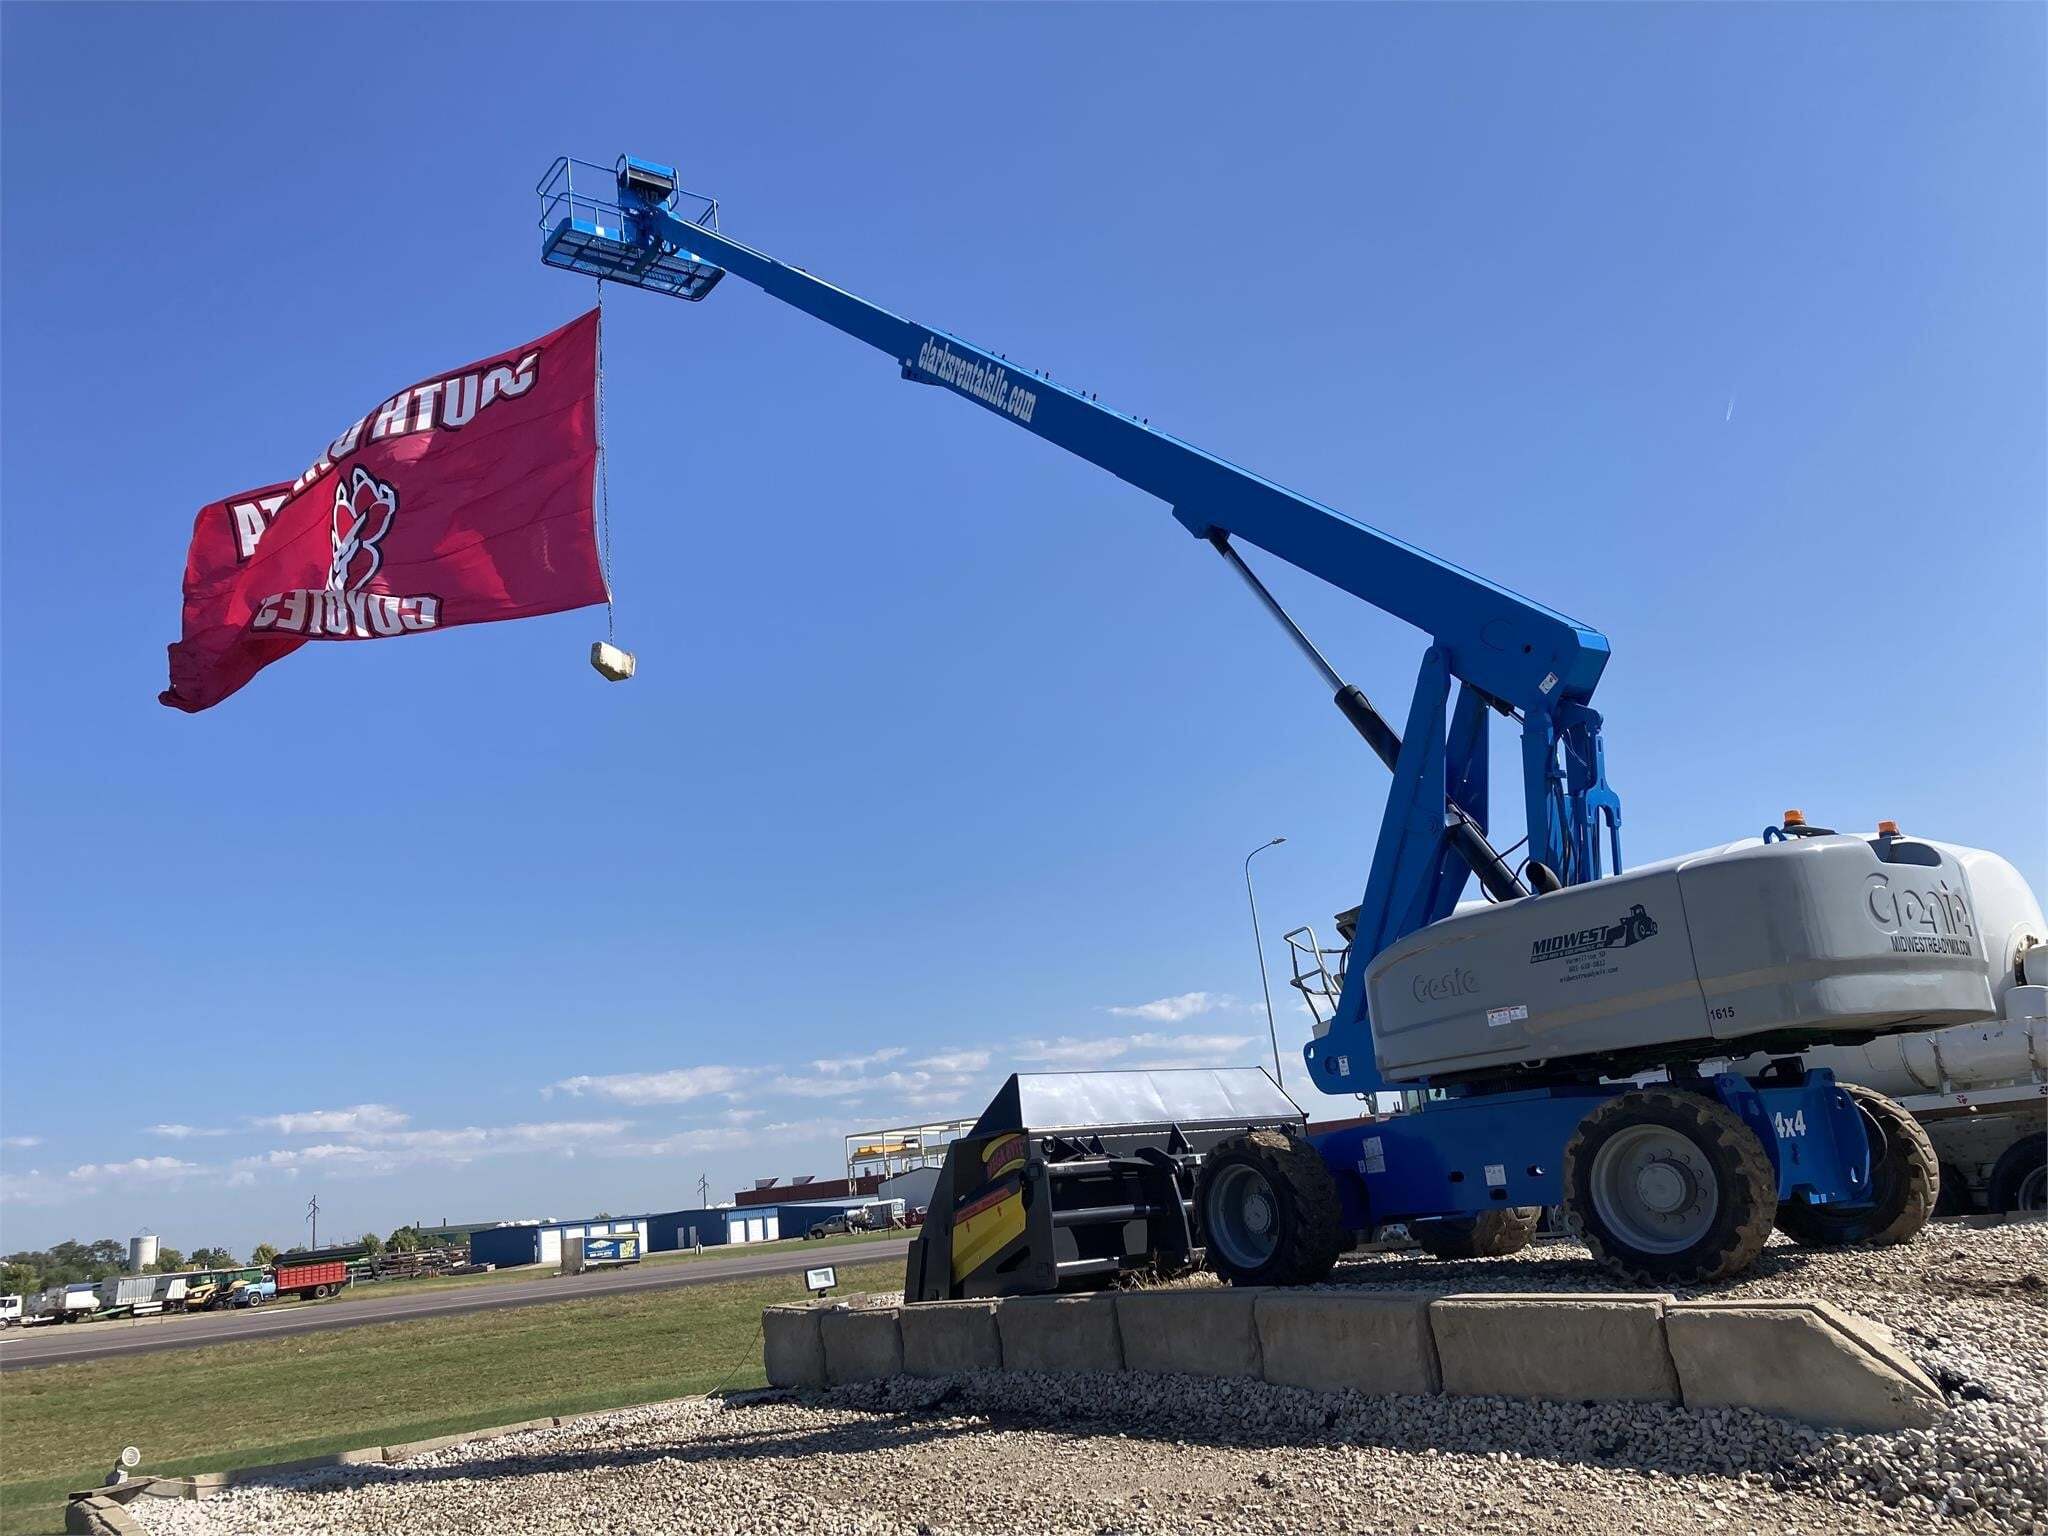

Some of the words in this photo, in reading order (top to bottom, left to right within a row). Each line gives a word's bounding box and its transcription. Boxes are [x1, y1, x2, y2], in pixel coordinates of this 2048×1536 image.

[918, 336, 1037, 423] clarksrentalsllc.com
[1532, 925, 1610, 955] MIDWEST
[1890, 935, 1973, 957] MIDWESTREADYMIX.COM
[1413, 968, 1480, 1003] Genie
[1710, 1006, 1735, 1020] 1615
[1775, 1110, 1806, 1138] 4x4
